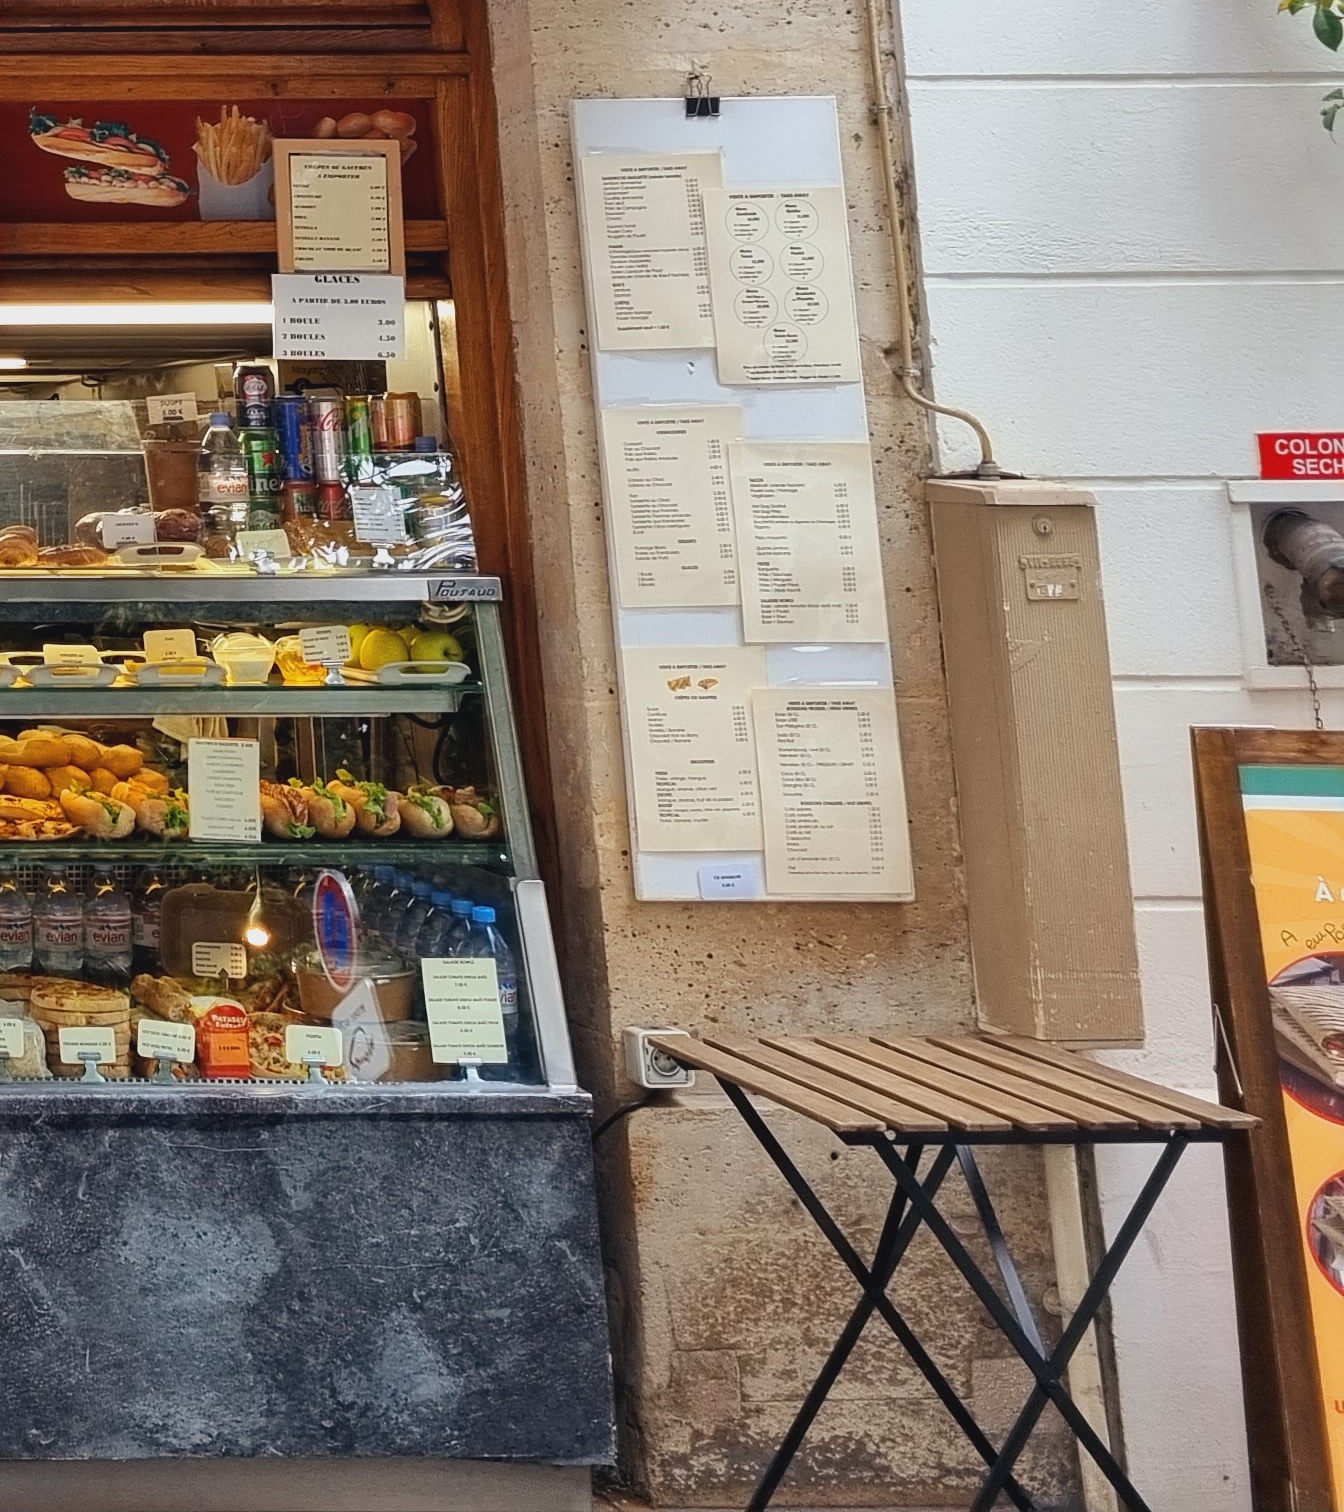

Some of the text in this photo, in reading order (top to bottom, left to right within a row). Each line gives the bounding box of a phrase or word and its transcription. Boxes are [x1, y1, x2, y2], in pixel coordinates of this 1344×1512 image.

[314, 275, 360, 284] GLACES
[1275, 438, 1344, 455] COLON
[217, 482, 247, 494] evian
[1316, 876, 1335, 902] À
[0, 930, 30, 942] evian
[46, 931, 77, 943] evian
[93, 931, 125, 943] evian
